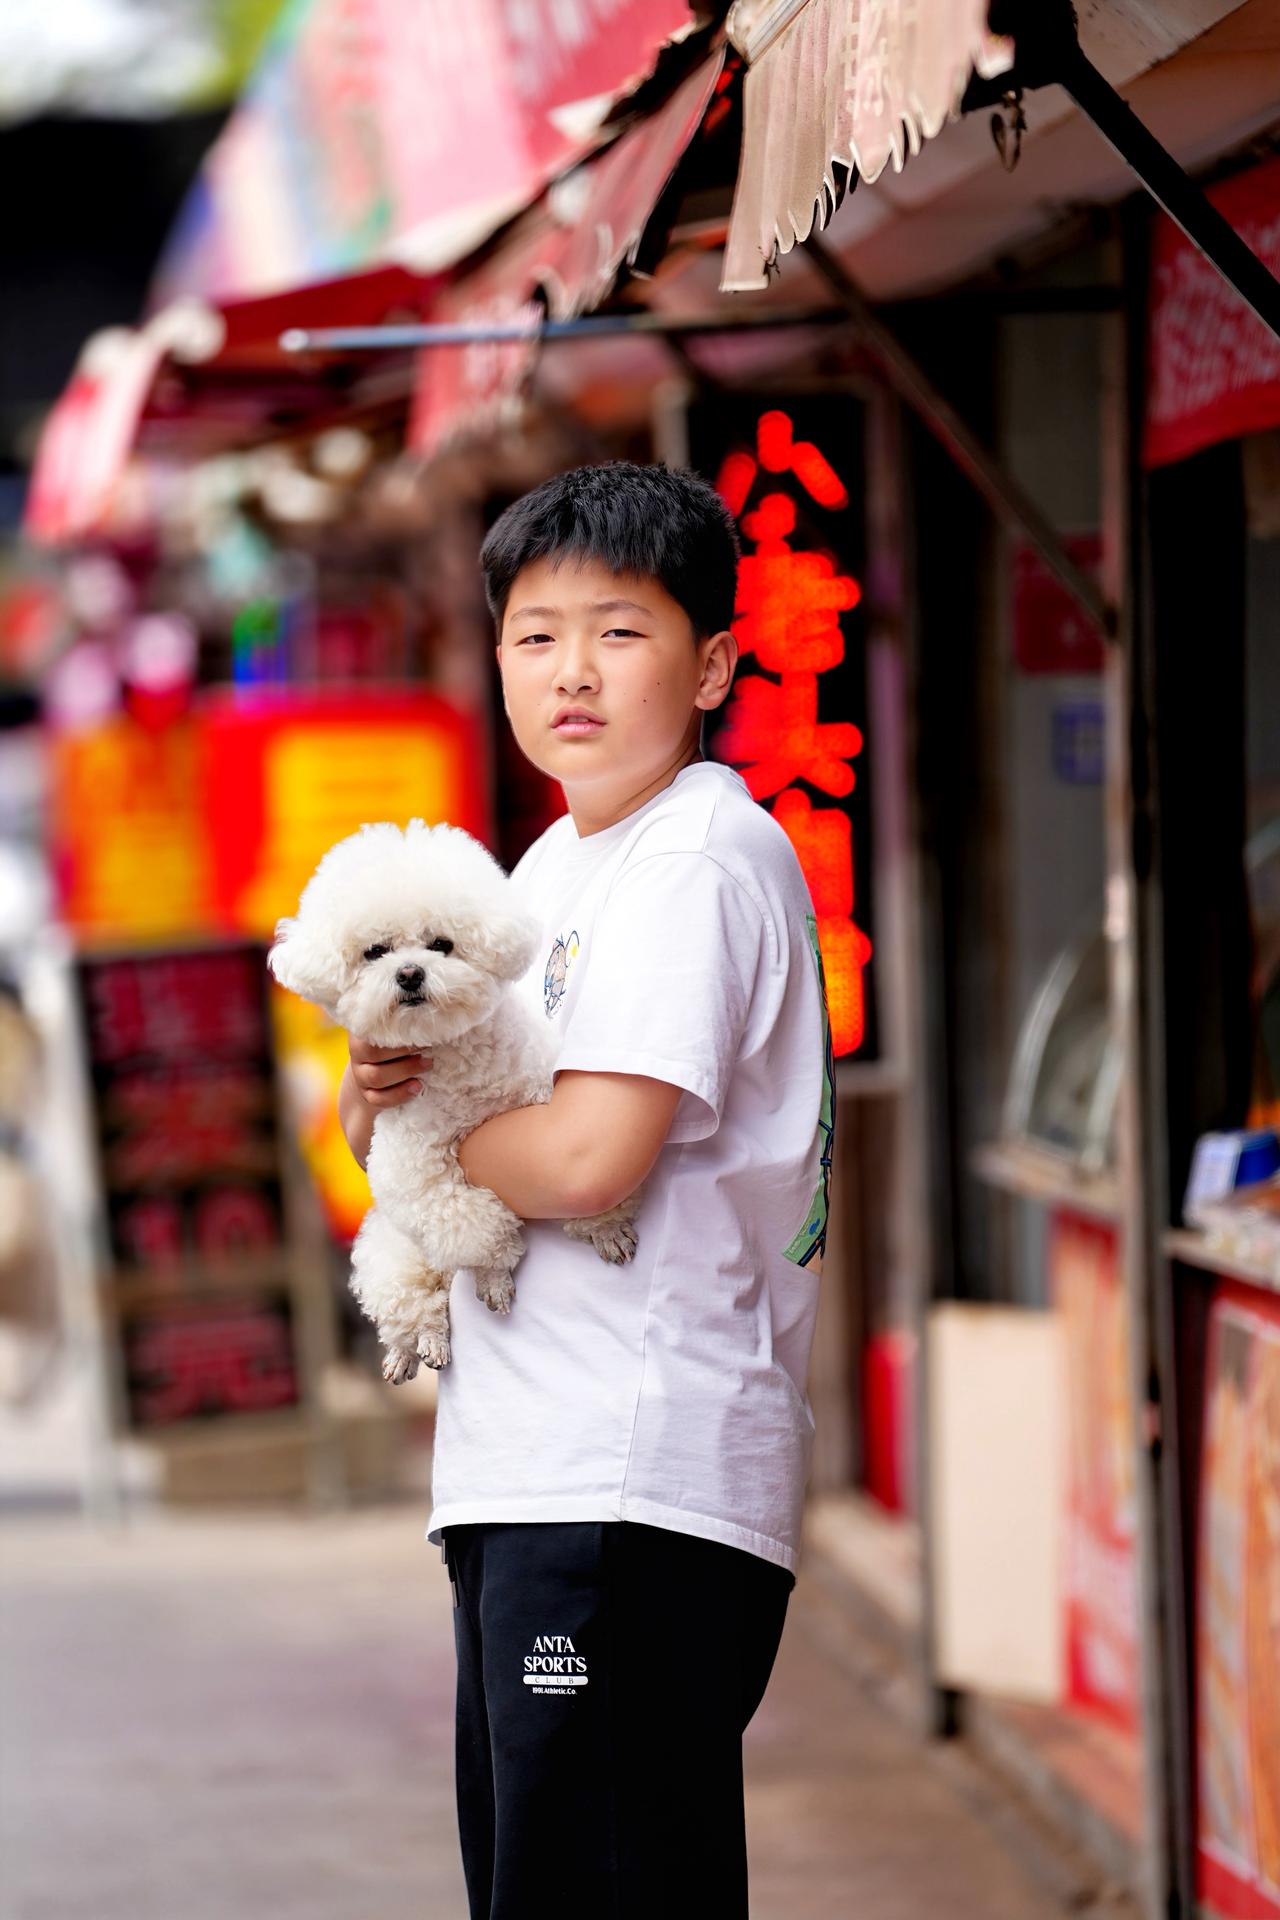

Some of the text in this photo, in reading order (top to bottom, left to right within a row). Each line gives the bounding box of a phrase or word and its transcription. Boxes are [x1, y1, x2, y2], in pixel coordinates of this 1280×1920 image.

[533, 1635, 576, 1653] ANTA
[523, 1655, 588, 1673] SPORTS
[534, 1676, 575, 1685] CLUB
